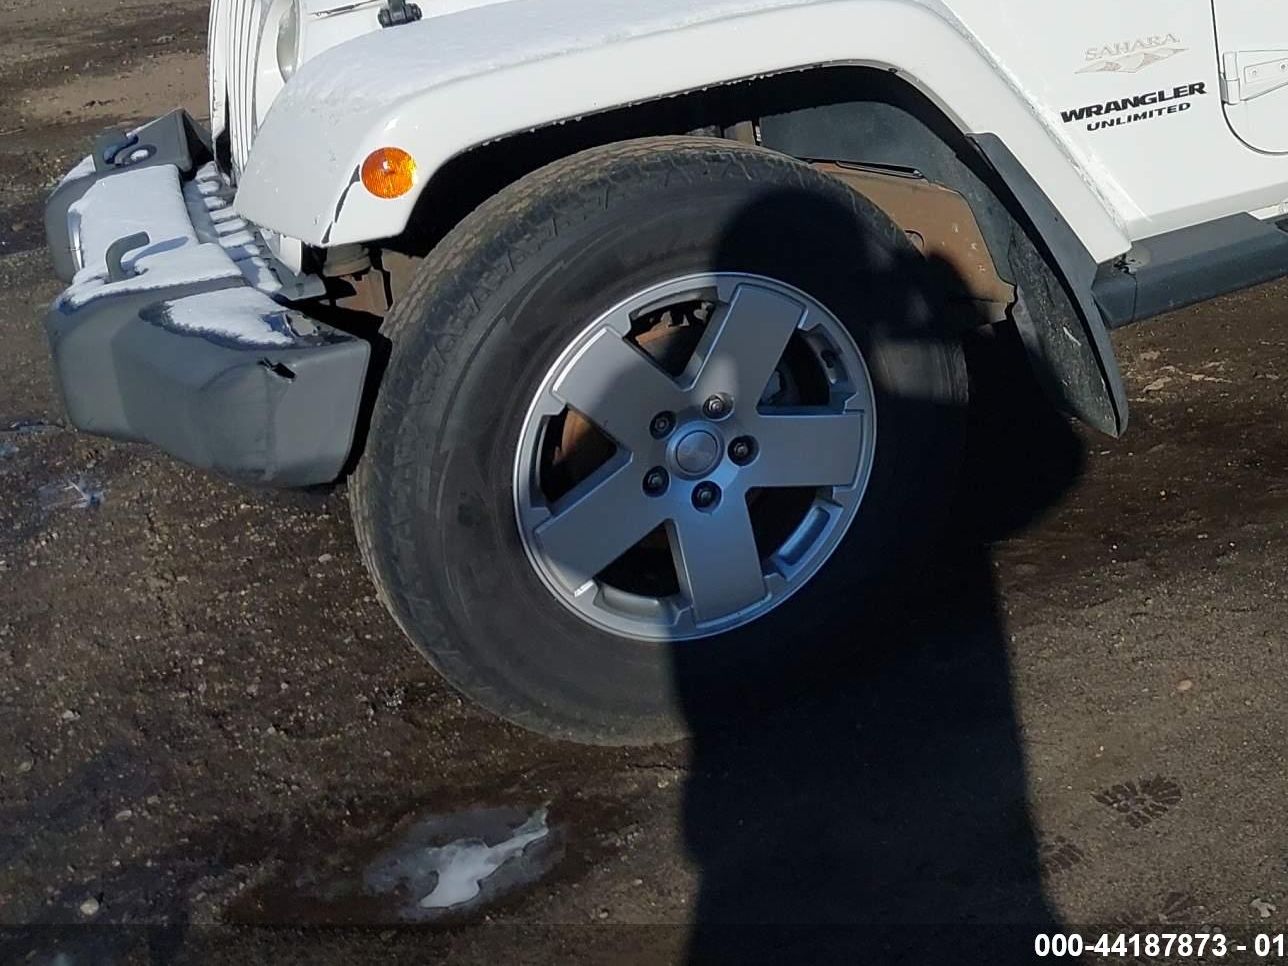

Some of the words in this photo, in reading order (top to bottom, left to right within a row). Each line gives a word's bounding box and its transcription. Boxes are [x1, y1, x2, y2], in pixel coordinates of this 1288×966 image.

[1084, 33, 1181, 62] SAHARA
[1060, 81, 1207, 124] WRANGLER
[1086, 102, 1192, 132] UNLIMITED
